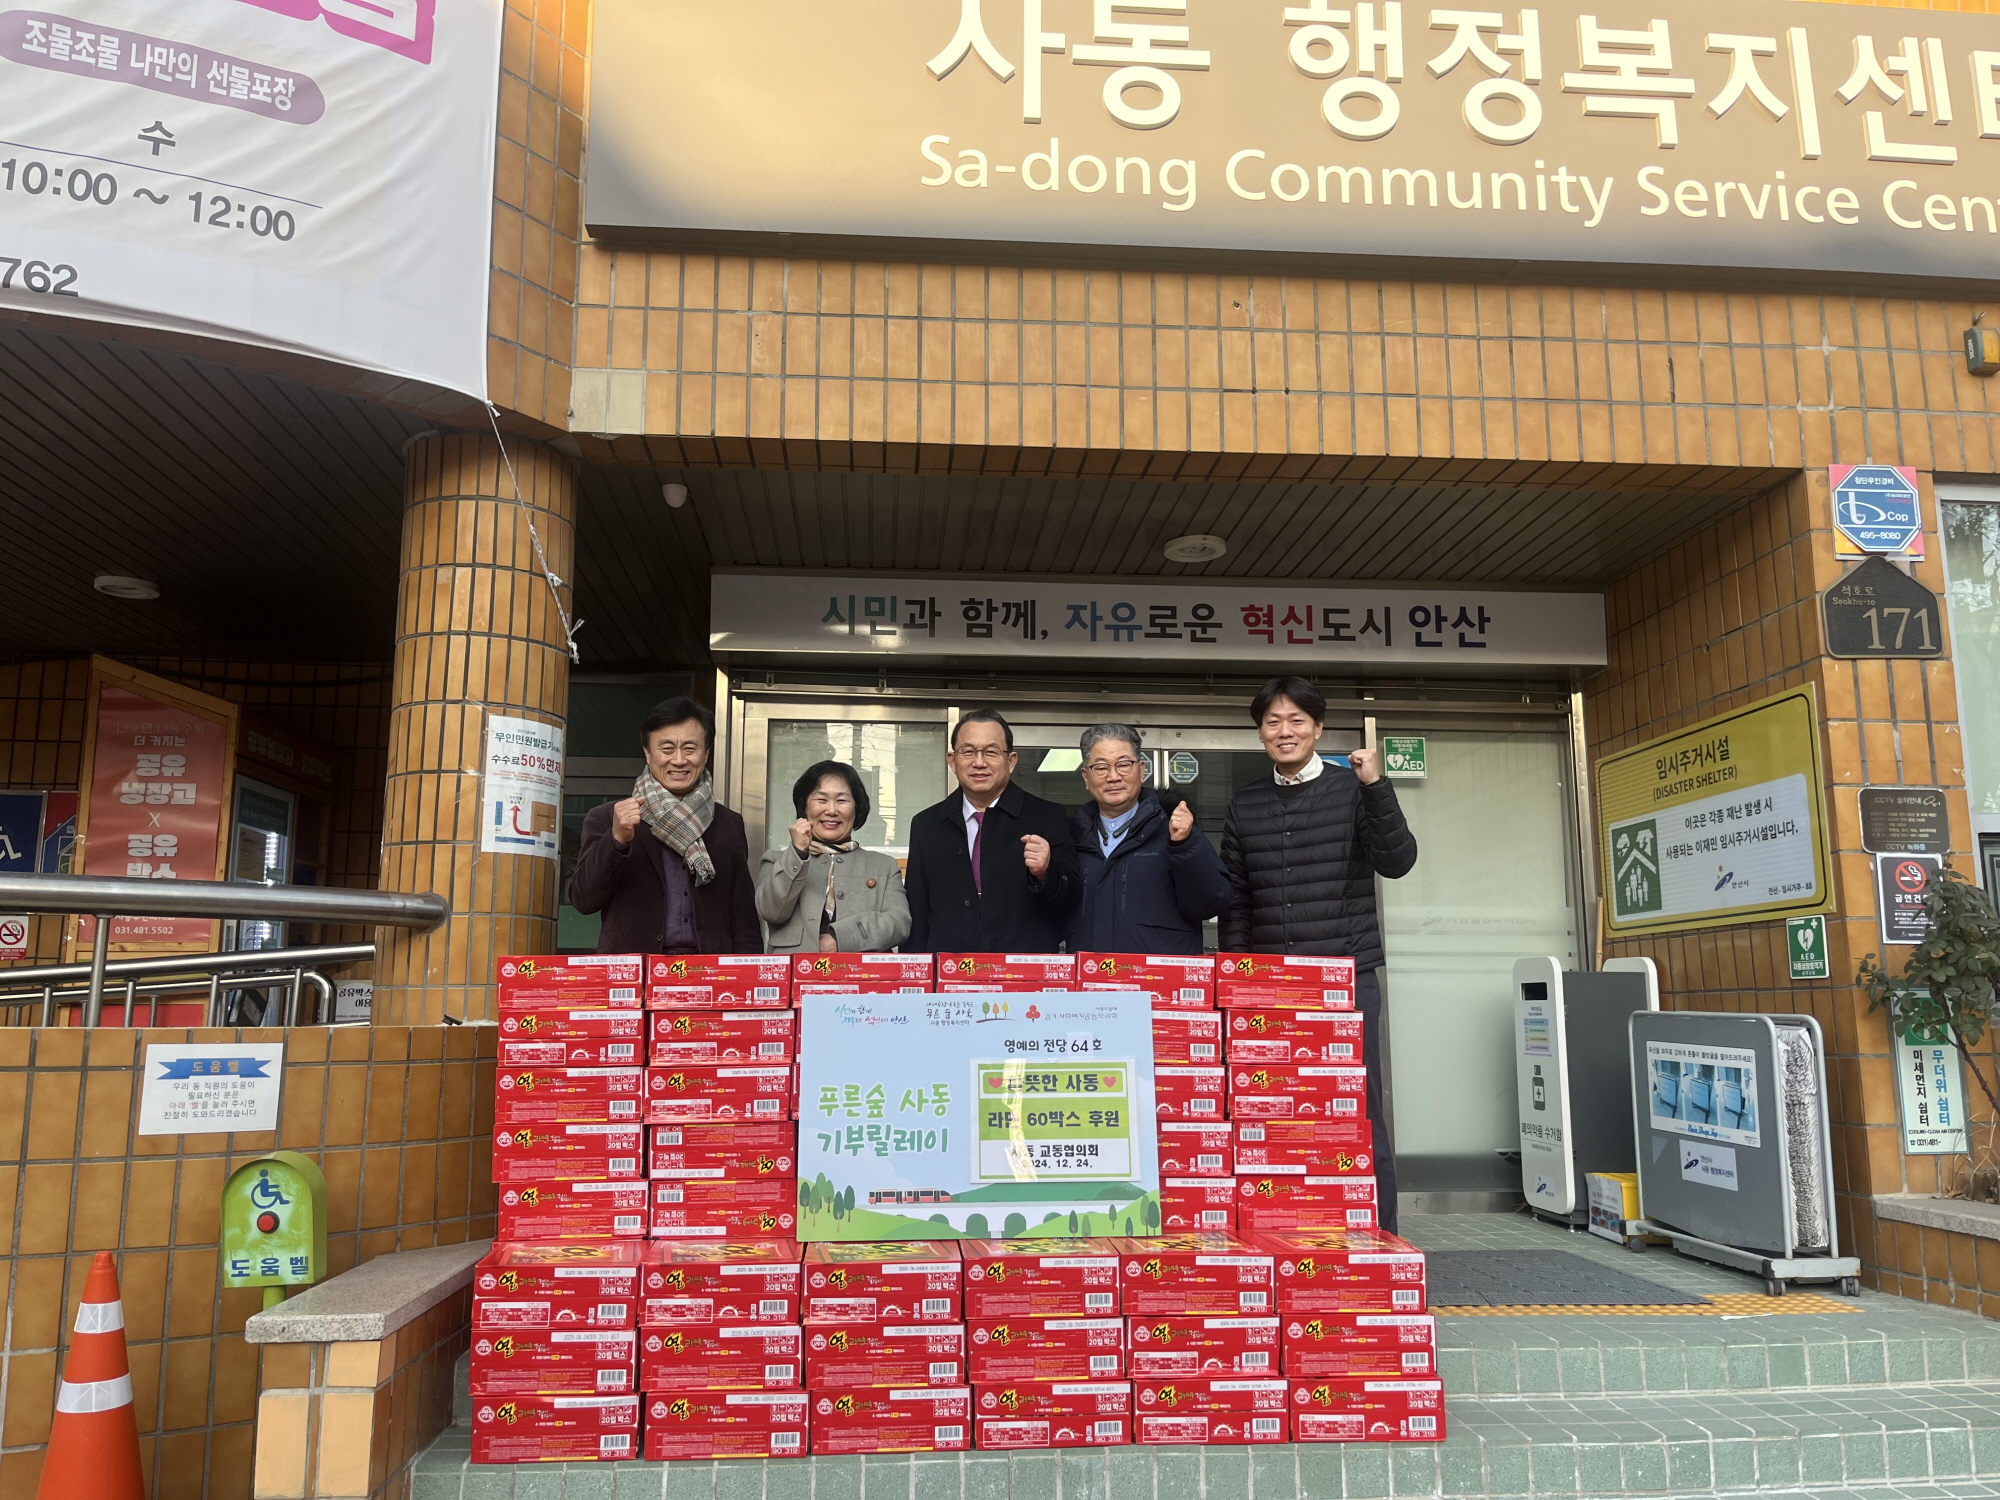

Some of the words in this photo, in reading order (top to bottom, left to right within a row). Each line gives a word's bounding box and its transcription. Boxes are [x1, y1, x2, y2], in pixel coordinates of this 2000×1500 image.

[22, 19, 121, 71] 조물조물
[129, 42, 198, 89] 나만의
[206, 63, 295, 112] 선물포장
[926, 0, 1211, 129] 사동
[1283, 0, 2000, 164] 행정복지센
[137, 121, 176, 156] 수
[920, 135, 1197, 212] Sa-dong
[1225, 149, 1613, 228] Community
[1637, 166, 1860, 225] Service
[1883, 180, 2000, 234] Cen
[1, 158, 118, 205] 10:00
[188, 191, 295, 242] 12:00
[0, 257, 79, 298] 762
[1887, 512, 1908, 523] Cop
[1860, 532, 1900, 540] 495-8080
[821, 595, 942, 637] 시민과
[960, 598, 1048, 640] 함께,
[1064, 601, 1223, 643] 자유로운
[1240, 603, 1392, 648] 혁신도시
[1408, 605, 1491, 649] 안산
[1863, 608, 1936, 650] 171
[134, 736, 145, 746] 더
[150, 736, 185, 746] 커지는
[136, 754, 186, 777] 공유
[1403, 761, 1423, 770] AED
[1656, 736, 1730, 780] 임시주거시설
[120, 782, 196, 804] 냉장고
[1653, 776, 1694, 802] (DISASTER
[1697, 765, 1737, 789] SHELTER)
[1685, 815, 1706, 830] 이곳은
[1709, 809, 1724, 824] 각종
[1727, 804, 1742, 820] 재난
[1744, 800, 1761, 816] 발생
[1764, 797, 1772, 811] 시
[128, 834, 178, 857] 공유
[1666, 843, 1693, 860] 사용되는
[1696, 836, 1717, 853] 이재민
[1720, 820, 1798, 849] 임시주거시설입니다.
[1004, 1039, 1039, 1053] 영예의
[1044, 1039, 1067, 1052] 전당
[1071, 1040, 1088, 1052] 64
[1093, 1039, 1101, 1051] 호
[1913, 1050, 1926, 1098] 미세먼지
[1933, 1050, 1947, 1092] 무더위
[204, 1082, 228, 1090] 직원의
[231, 1081, 255, 1089] 도움이
[1066, 1074, 1098, 1092] 사동
[188, 1092, 220, 1100] 필요하신
[224, 1091, 239, 1099] 분은
[819, 1083, 886, 1118] 푸른숲
[899, 1083, 950, 1116] 사동
[164, 1111, 188, 1119] 친절히
[192, 1110, 258, 1118] 도와드리겠습니다.
[1027, 1111, 1081, 1127] 60박스
[1089, 1111, 1119, 1127] 후원
[1918, 1102, 1929, 1126] 쉼터
[1938, 1098, 1950, 1126] 쉼터
[817, 1124, 948, 1157] 기부릴레이
[1521, 1123, 1542, 1138] 폐의약품
[1545, 1127, 1562, 1141] 수거함
[1040, 1145, 1098, 1157] 교동협의회
[1056, 1160, 1071, 1168] 12.
[1076, 1159, 1092, 1168] 24.
[616, 1415, 631, 1424] 박스
[786, 1414, 801, 1422] 박스
